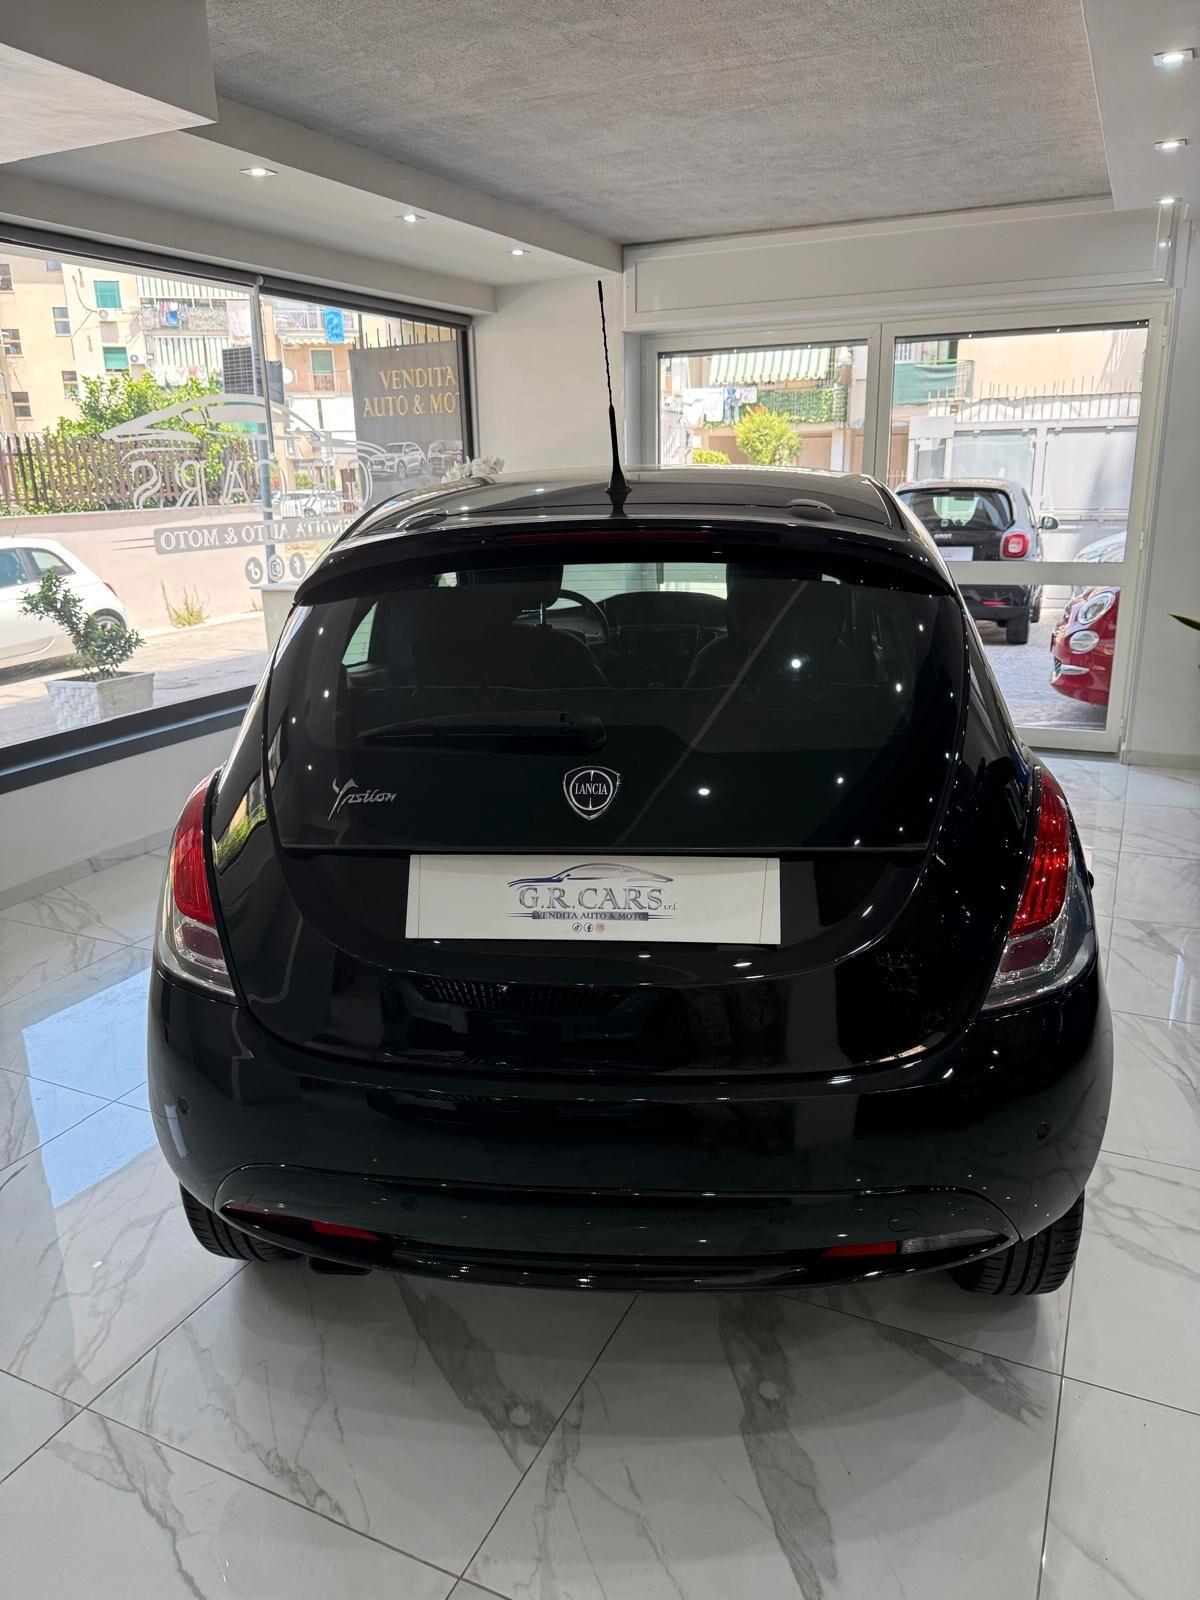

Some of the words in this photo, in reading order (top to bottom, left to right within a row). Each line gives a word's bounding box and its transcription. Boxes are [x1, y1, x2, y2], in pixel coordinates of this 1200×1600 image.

[380, 366, 459, 390] VENDITA
[363, 395, 409, 417] AUTO
[413, 394, 426, 415] &
[327, 777, 397, 821] Ypsilon
[574, 783, 608, 795] LANCIA
[537, 911, 578, 920] VENDITA
[580, 911, 607, 920] AUTO
[608, 912, 618, 920] &
[619, 912, 648, 921] MOTO
